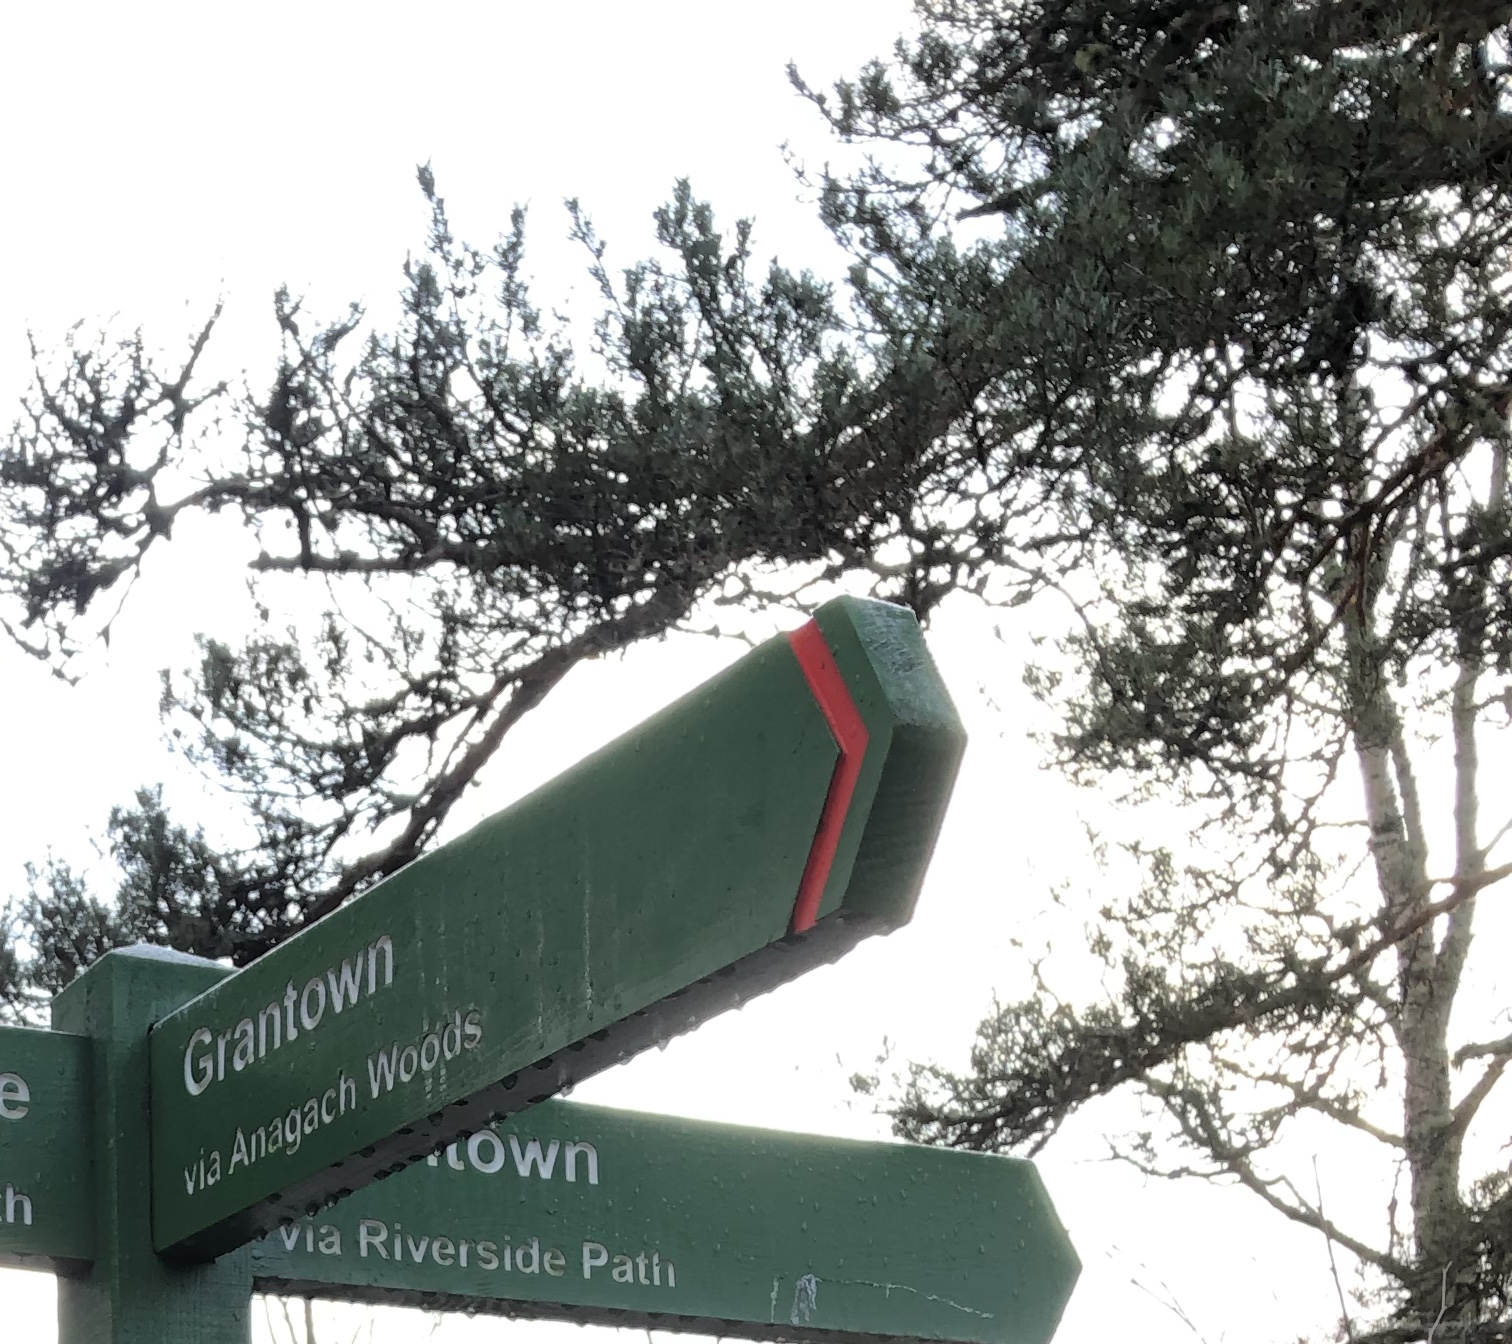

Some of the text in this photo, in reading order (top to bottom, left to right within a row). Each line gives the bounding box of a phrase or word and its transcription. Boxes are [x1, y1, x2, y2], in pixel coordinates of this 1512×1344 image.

[184, 935, 394, 1097] Grantown
[184, 1009, 483, 1195] via Anagach Woods
[427, 1130, 599, 1185] town
[280, 1216, 677, 1288] via Riverside Path
